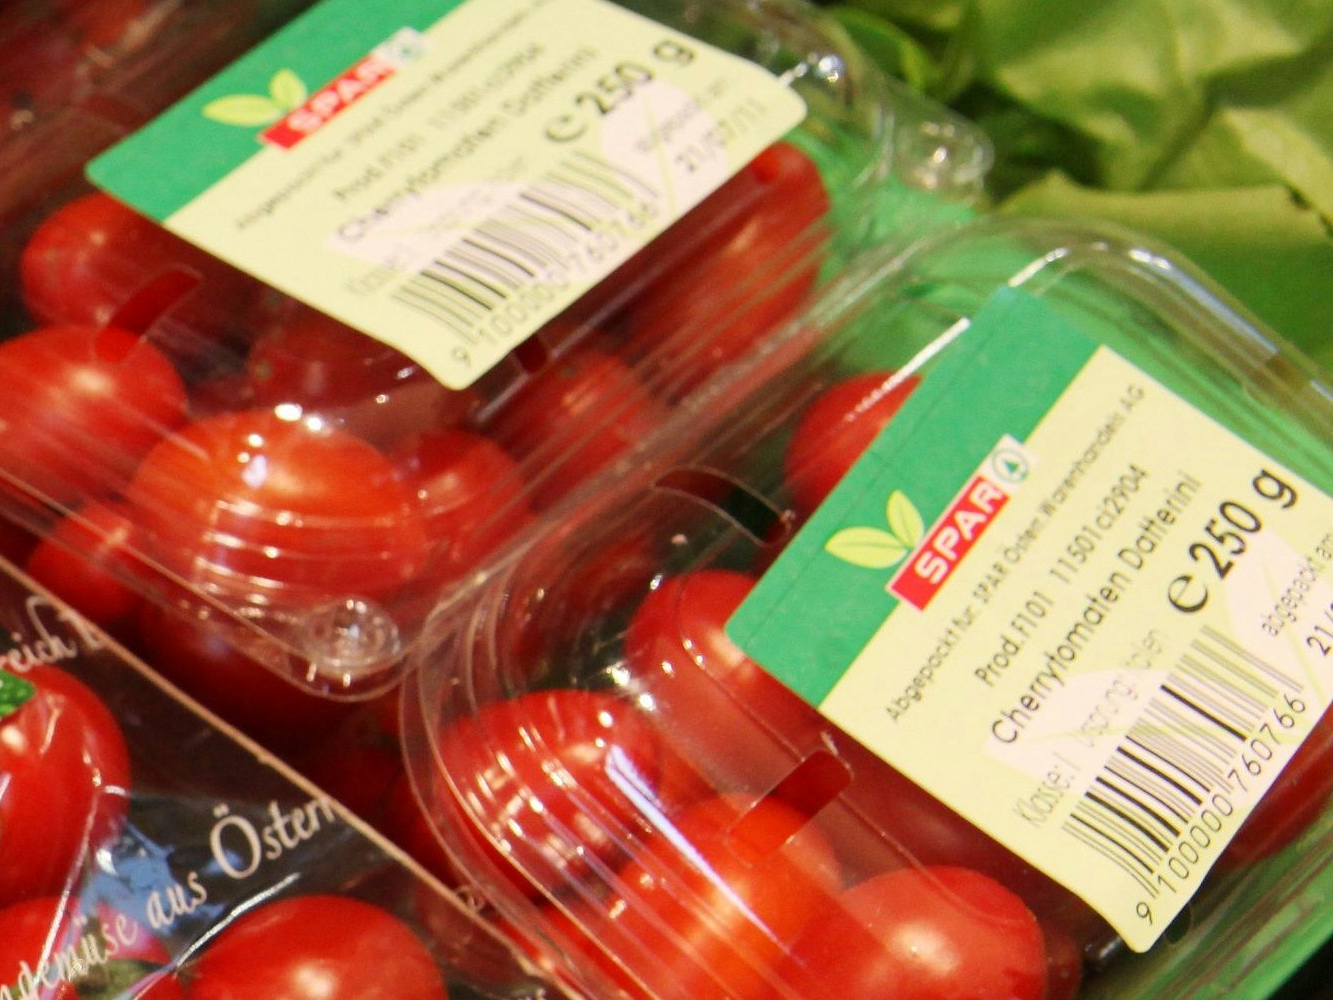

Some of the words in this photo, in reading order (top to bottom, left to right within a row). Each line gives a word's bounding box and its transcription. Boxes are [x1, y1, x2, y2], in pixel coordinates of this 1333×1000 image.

[285, 54, 393, 133] SPAR
[574, 59, 655, 117] 250
[653, 39, 697, 68] g
[913, 479, 1007, 585] SPAR
[1188, 499, 1263, 581] 250
[1251, 468, 1300, 510] g
[991, 570, 1130, 744] Cherrytomaten
[1117, 471, 1203, 571] Datterini
[1135, 901, 1154, 927] 9
[1156, 792, 1234, 894] 100000
[1227, 692, 1307, 793] 760766
[146, 868, 209, 931] aus
